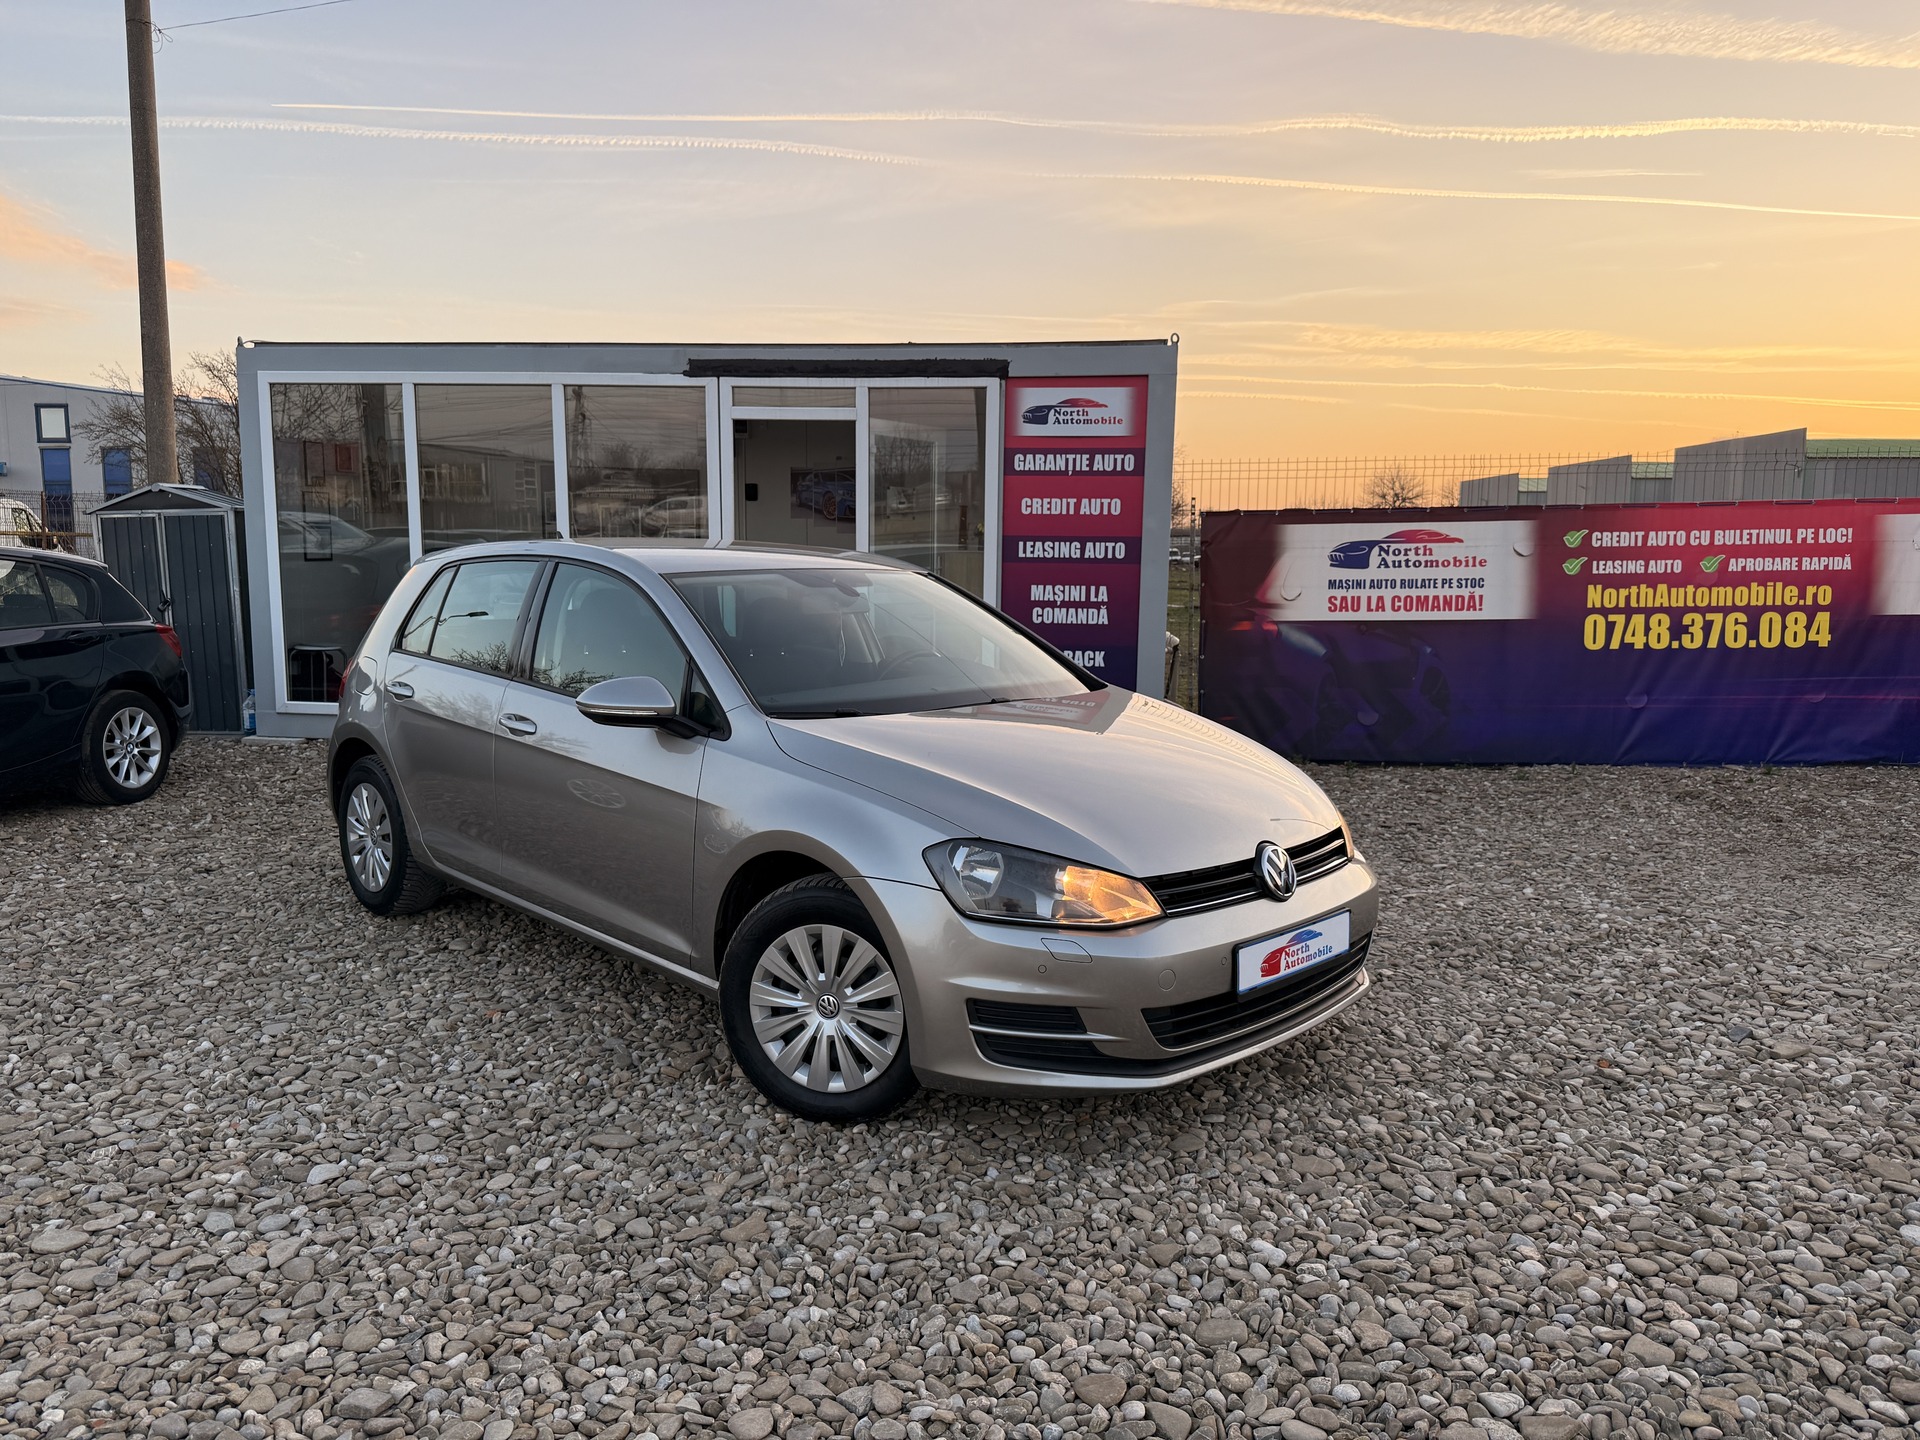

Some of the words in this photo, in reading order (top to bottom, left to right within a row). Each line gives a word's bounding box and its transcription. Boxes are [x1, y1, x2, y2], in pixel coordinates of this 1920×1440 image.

[1053, 408, 1089, 417] North
[1053, 416, 1123, 425] Automobile
[1014, 454, 1089, 476] GARANȚIE
[1093, 454, 1135, 472] AUTO
[1021, 498, 1077, 515] CREDIT
[1080, 498, 1121, 516] AUTO
[1591, 531, 1645, 547] CREDIT
[1647, 531, 1686, 546] AUTO
[1690, 530, 1710, 546] CU
[1714, 529, 1793, 545] BULETINUL
[1797, 528, 1815, 544] PE
[1818, 528, 1853, 543] LOC!
[1018, 541, 1081, 559] LEASING
[1084, 542, 1126, 560] AUTO
[1377, 545, 1434, 557] North
[1377, 556, 1487, 569] Automobile
[1592, 560, 1645, 574] LEASING
[1648, 559, 1682, 574] AUTO
[1728, 557, 1798, 572] APROBARE
[1802, 554, 1852, 571] RAPIDĂ
[1328, 578, 1366, 592] MAȘINI
[1369, 578, 1397, 590] AUTO
[1400, 578, 1438, 589] RULATE
[1441, 578, 1454, 589] PE
[1456, 577, 1484, 589] STOC
[1030, 584, 1086, 606] MAȘINI
[1090, 585, 1108, 602] LA
[1327, 595, 1361, 612] SAU
[1366, 595, 1386, 612] LA
[1390, 591, 1484, 612] COMANDĂ!
[1587, 582, 1833, 608] NorthAutomobile.ro
[1032, 606, 1108, 625] COMANDĂ
[1583, 611, 1832, 651] 0748.376.084
[1284, 943, 1310, 960] North
[1284, 944, 1333, 971] Automobile
